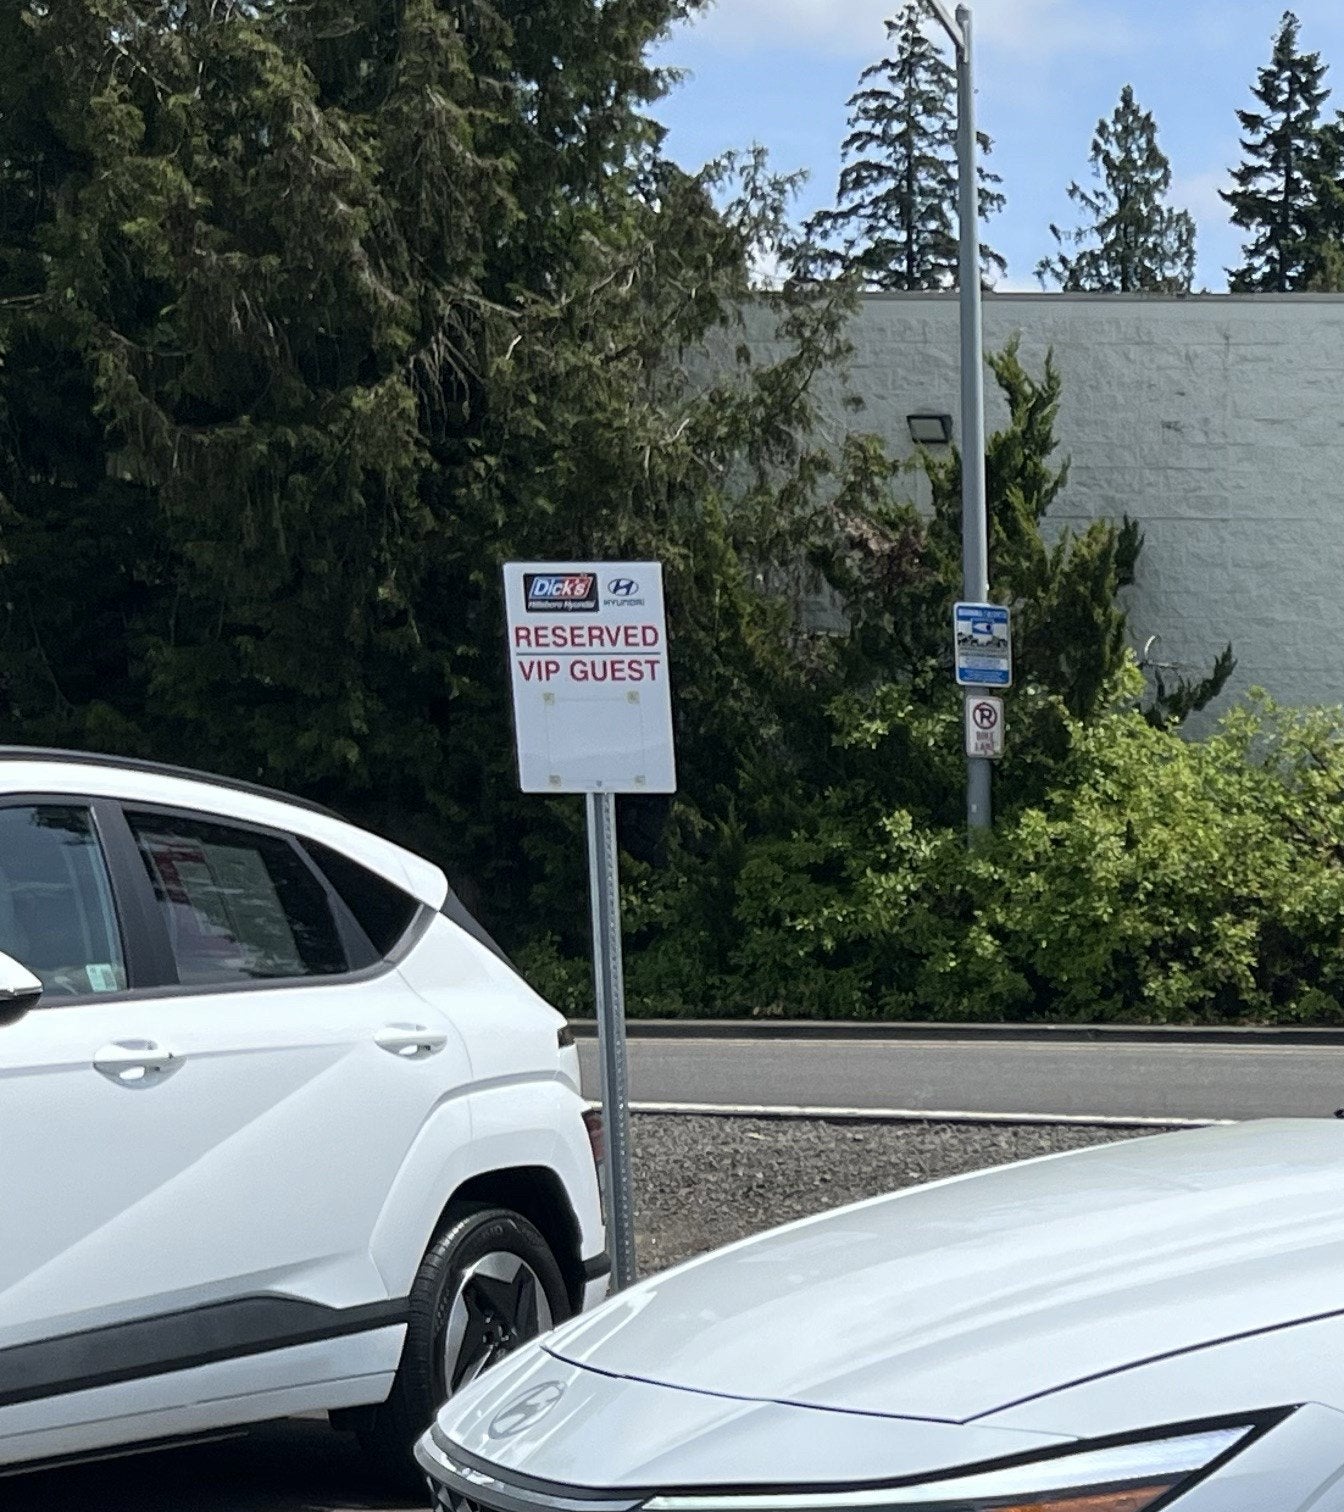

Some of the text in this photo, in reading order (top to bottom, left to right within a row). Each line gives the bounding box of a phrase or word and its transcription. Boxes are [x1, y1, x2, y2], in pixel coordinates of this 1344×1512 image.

[515, 625, 660, 648] RESERVED
[518, 659, 661, 682] VIP GUEST
